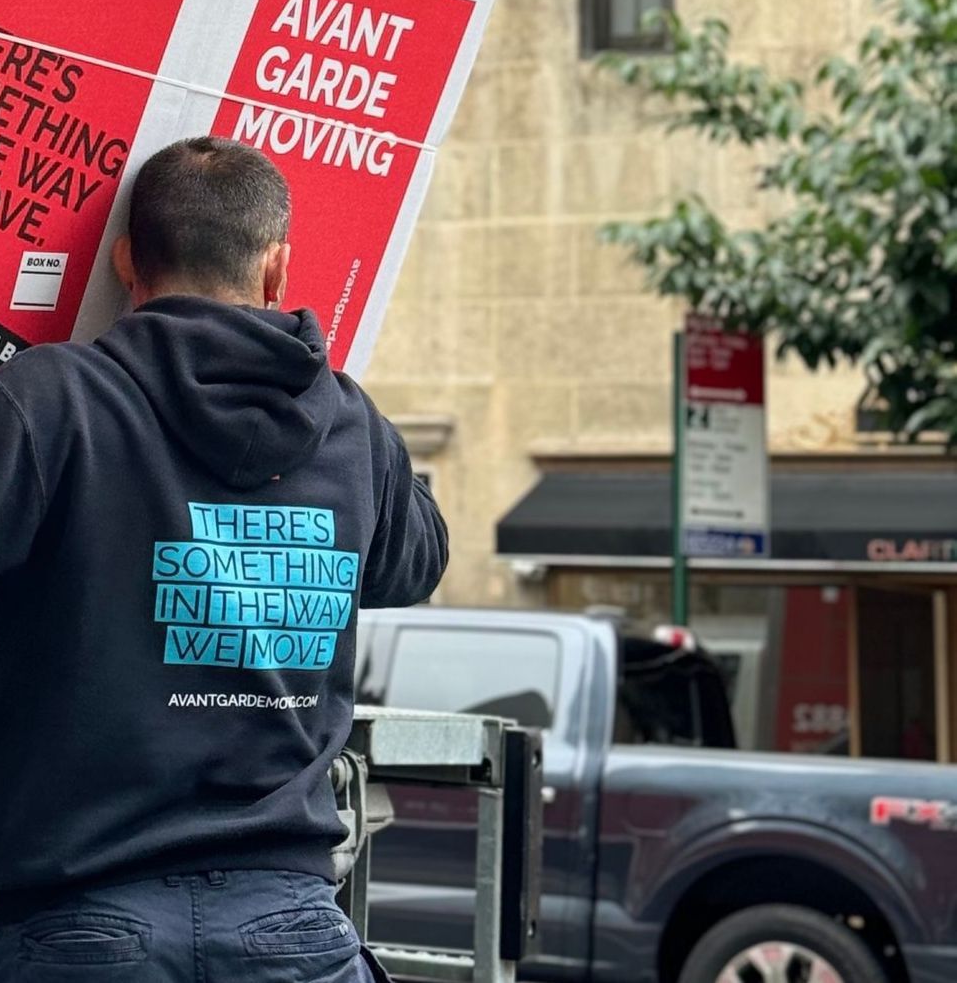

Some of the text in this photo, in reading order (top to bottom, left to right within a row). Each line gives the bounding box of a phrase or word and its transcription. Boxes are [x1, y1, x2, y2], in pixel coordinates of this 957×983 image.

[255, 45, 398, 119] GARDE
[231, 103, 397, 177] MOVING
[18, 147, 103, 214] WAY
[27, 258, 46, 267] BOX
[193, 506, 330, 543] THERE'S
[156, 546, 356, 586] SOMETHING
[160, 587, 350, 625] IN THE WAY
[171, 629, 330, 665] WE MOVE.
